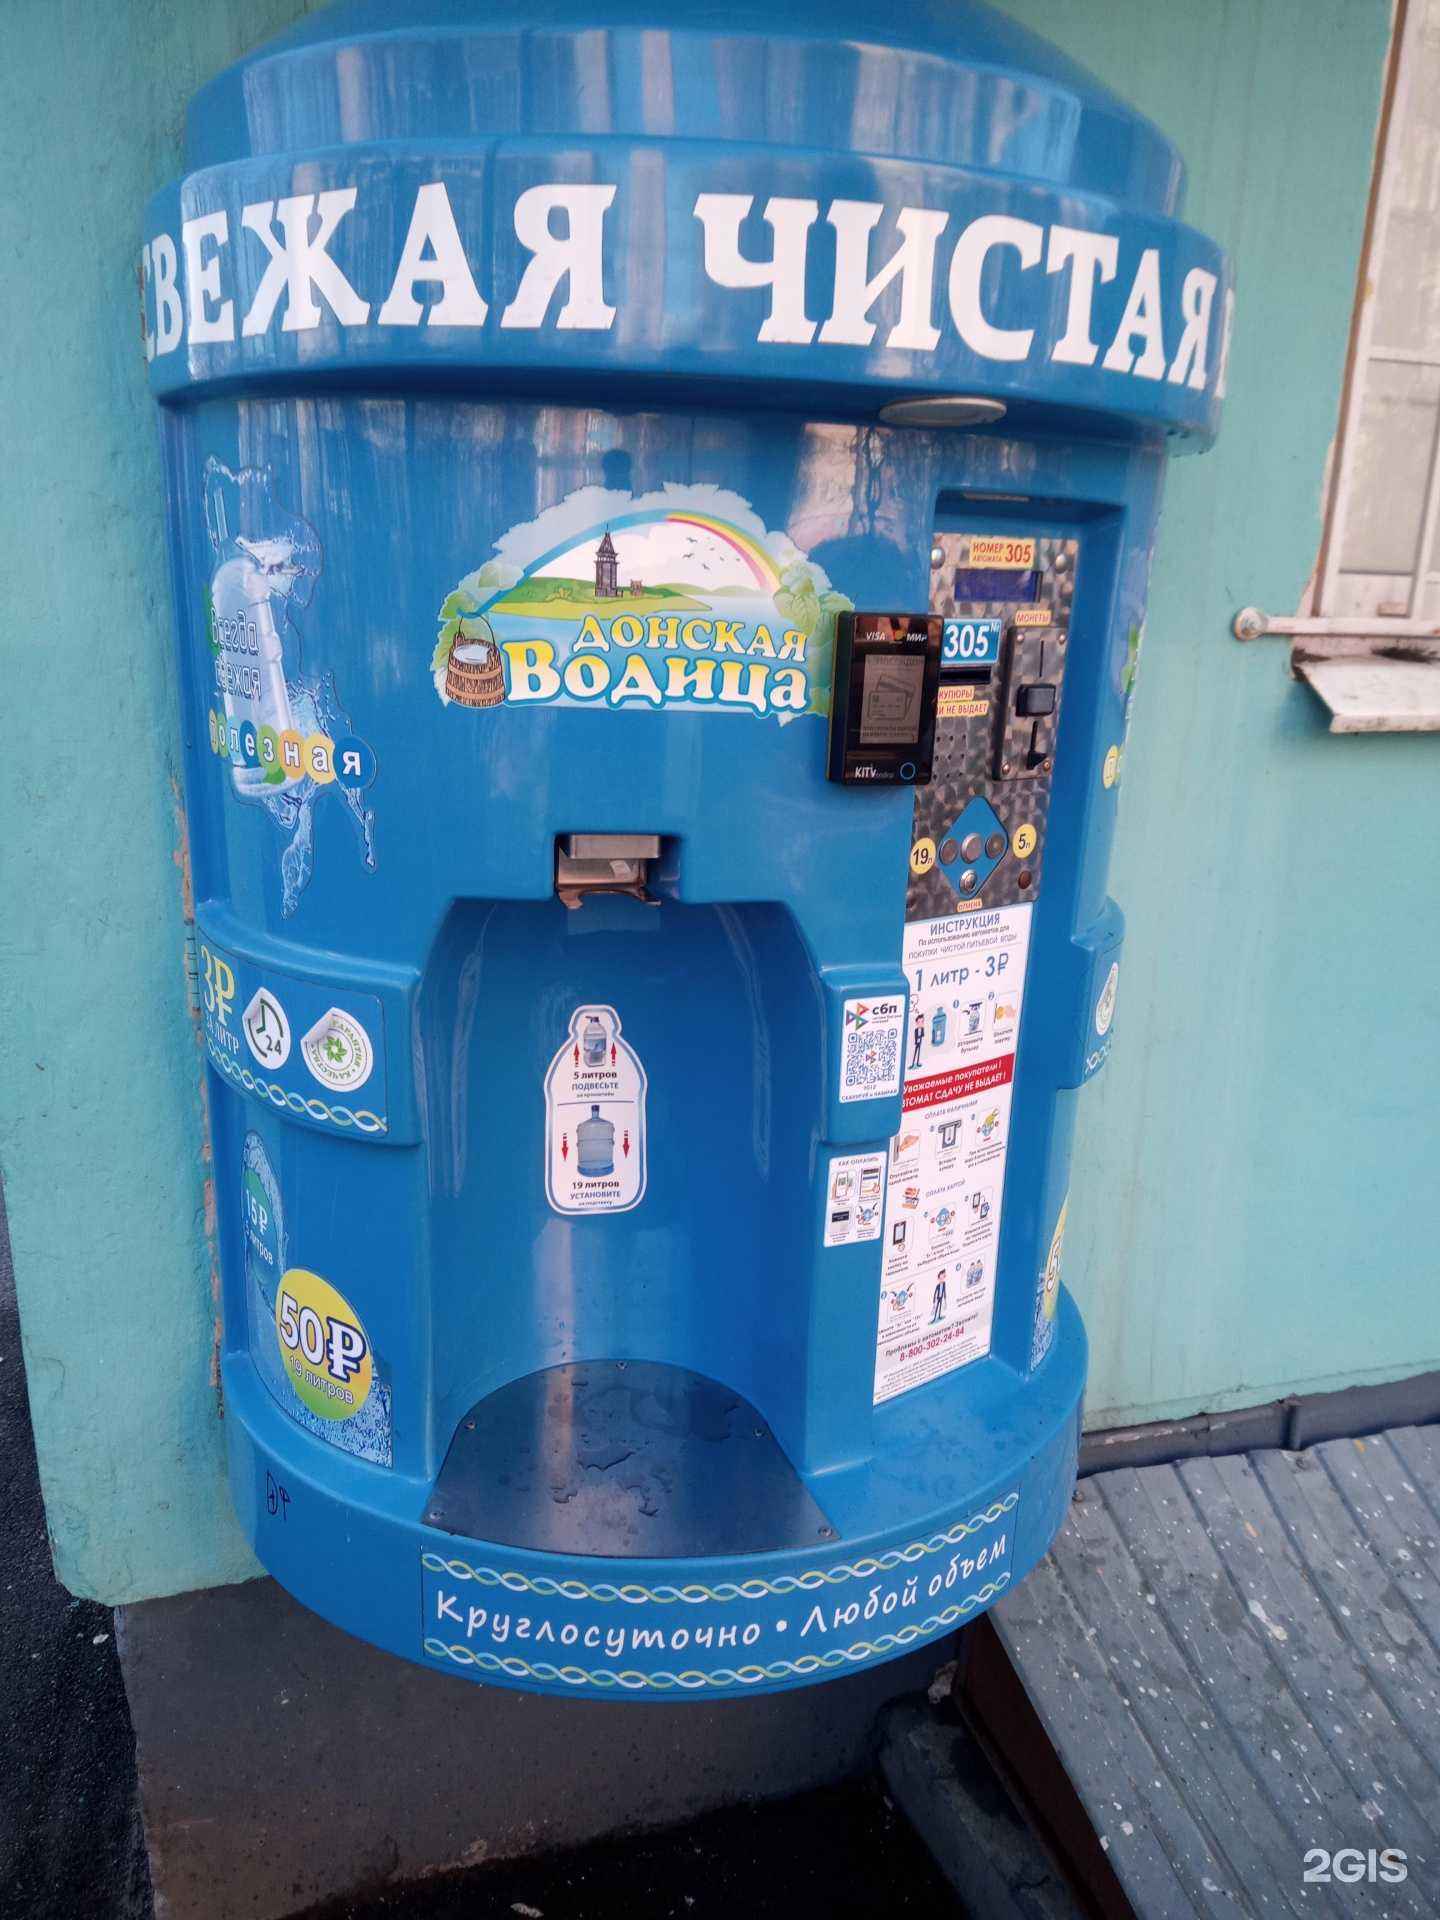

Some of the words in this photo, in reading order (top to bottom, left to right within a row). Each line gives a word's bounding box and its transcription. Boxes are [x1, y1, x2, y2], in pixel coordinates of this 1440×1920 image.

[692, 192, 1218, 390] ЧИСТАЯ
[973, 542, 1004, 553] НОМЕР
[1005, 543, 1032, 563] 305
[572, 615, 808, 661] ДОНСКАЯ
[865, 631, 887, 641] VISA
[906, 633, 928, 642] МИР
[943, 624, 990, 658] 305
[946, 704, 956, 714] НЕ
[958, 703, 987, 714] ВЫДАЕТ
[930, 913, 1001, 936] ИНСТРУКЦИЯ
[915, 968, 923, 992] 1
[930, 967, 969, 986] литр
[265, 1034, 282, 1056] 24
[572, 1081, 619, 1091] ПОДВЕСЬТЕ
[573, 1071, 580, 1080] 5
[581, 1071, 617, 1080] литров
[934, 1085, 964, 1099] СДАЧУ
[964, 1083, 974, 1091] НЕ
[570, 1190, 621, 1200] УСТАНОВИТЕ
[572, 1181, 583, 1190] 19
[585, 1180, 620, 1190] литров
[289, 1355, 304, 1377] 19
[305, 1370, 355, 1405] литров
[437, 1590, 760, 1657] Круглосуточно
[800, 1582, 917, 1637] Любой
[929, 1534, 1007, 1596] объем
